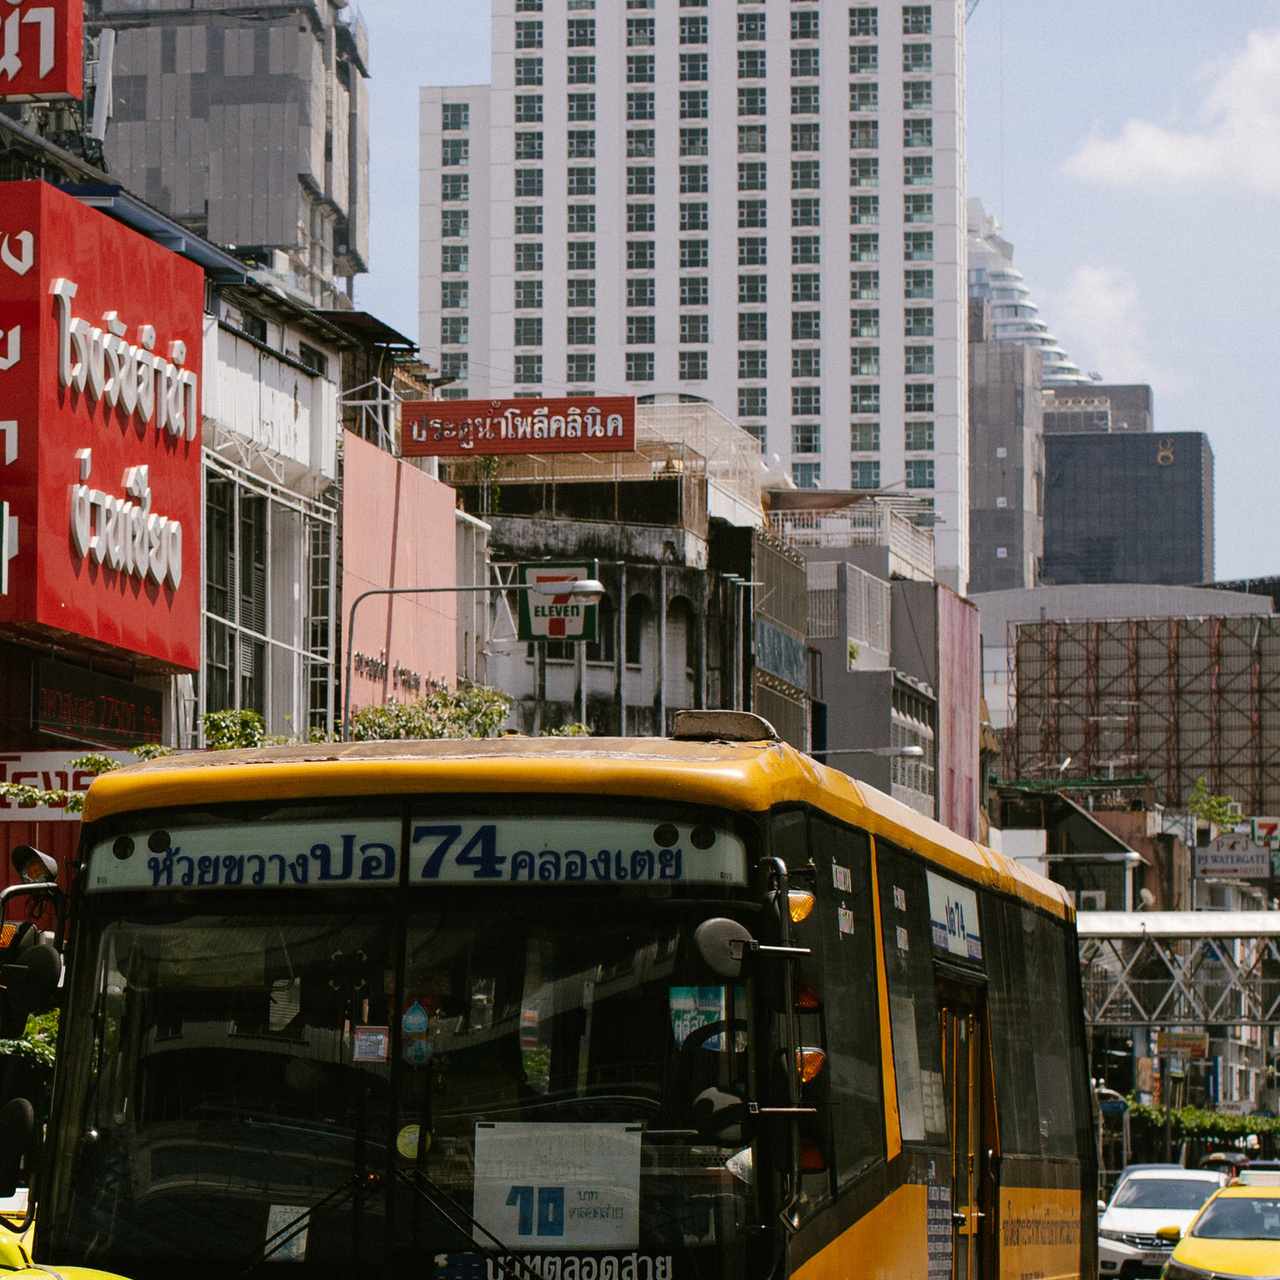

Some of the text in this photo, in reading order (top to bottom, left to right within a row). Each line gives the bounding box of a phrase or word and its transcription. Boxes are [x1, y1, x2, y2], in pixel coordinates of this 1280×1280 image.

[49, 277, 198, 442] โรงรับจำนำ
[148, 846, 309, 887] ห้วยขวาง
[412, 825, 507, 879] 74
[510, 848, 683, 882] คลองเตย
[1212, 855, 1267, 864] WATERGATE
[506, 1186, 565, 1236] 10
